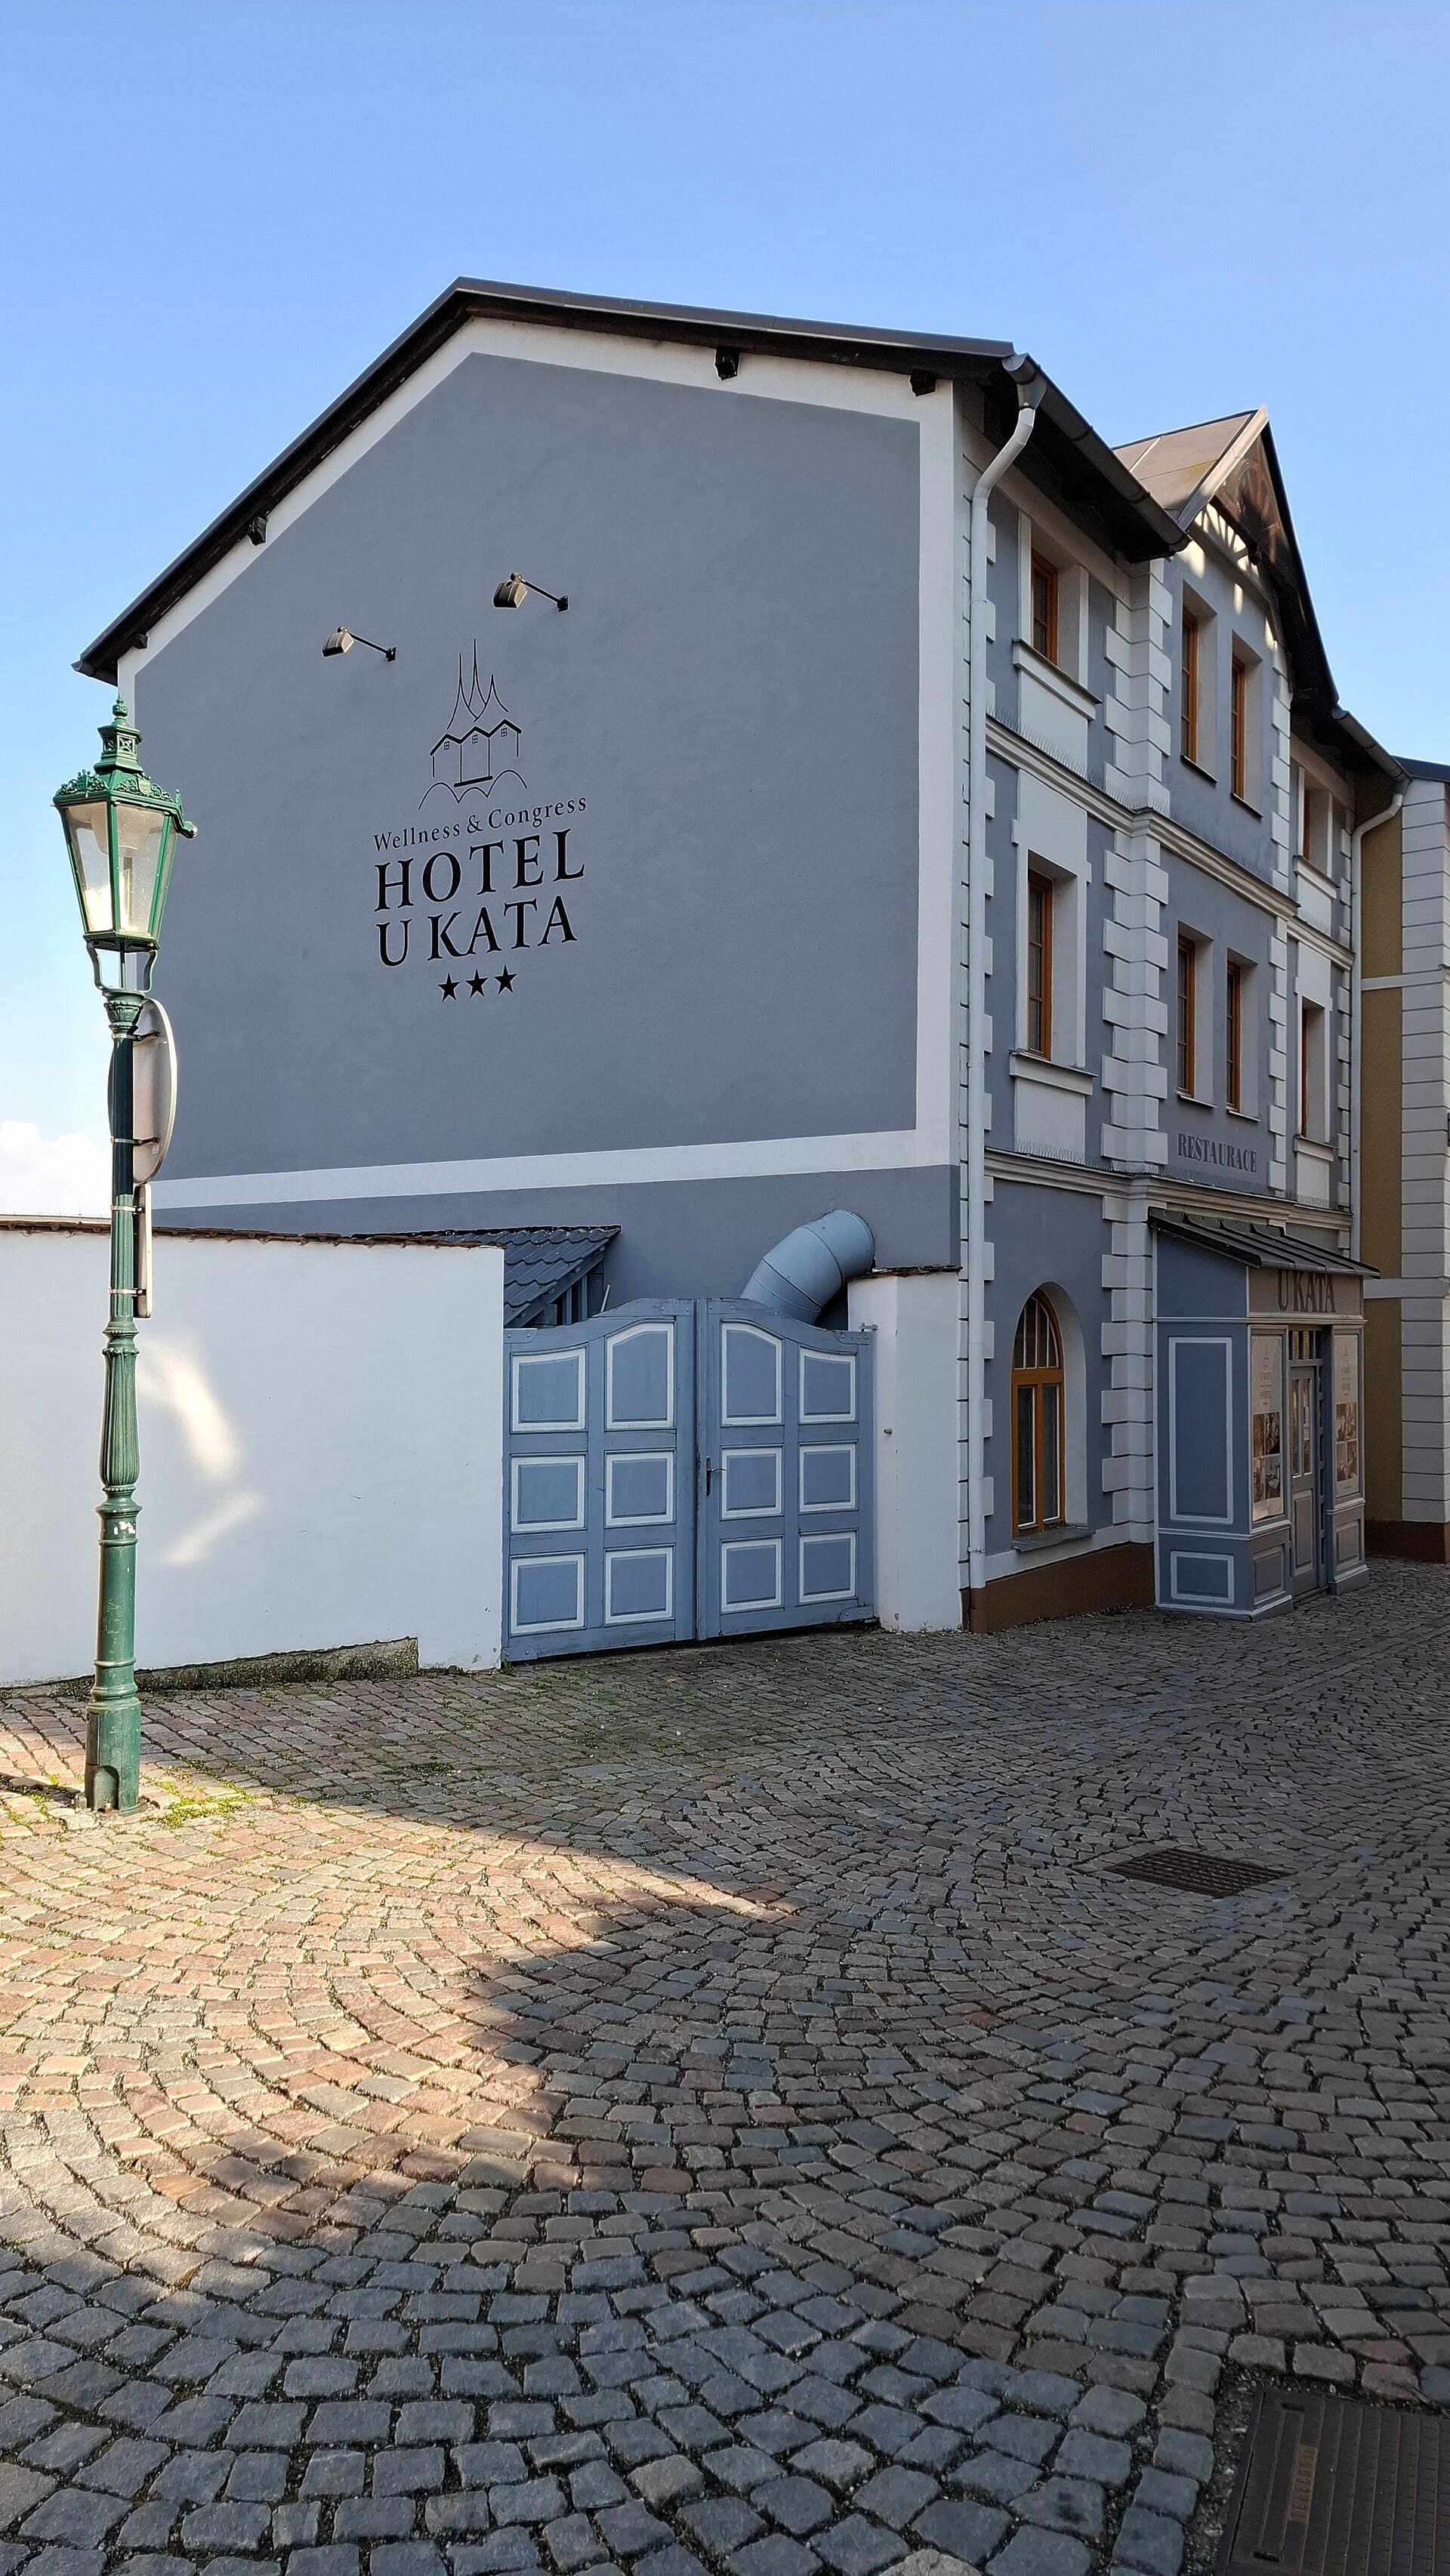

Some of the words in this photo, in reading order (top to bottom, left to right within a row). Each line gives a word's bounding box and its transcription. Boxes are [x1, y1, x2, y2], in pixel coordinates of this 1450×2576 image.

[373, 823, 461, 852] Wellness
[466, 815, 484, 835] &
[488, 797, 587, 828] Congress
[375, 828, 585, 912] HOTEL
[1177, 1132, 1257, 1172] RESTAURACE
